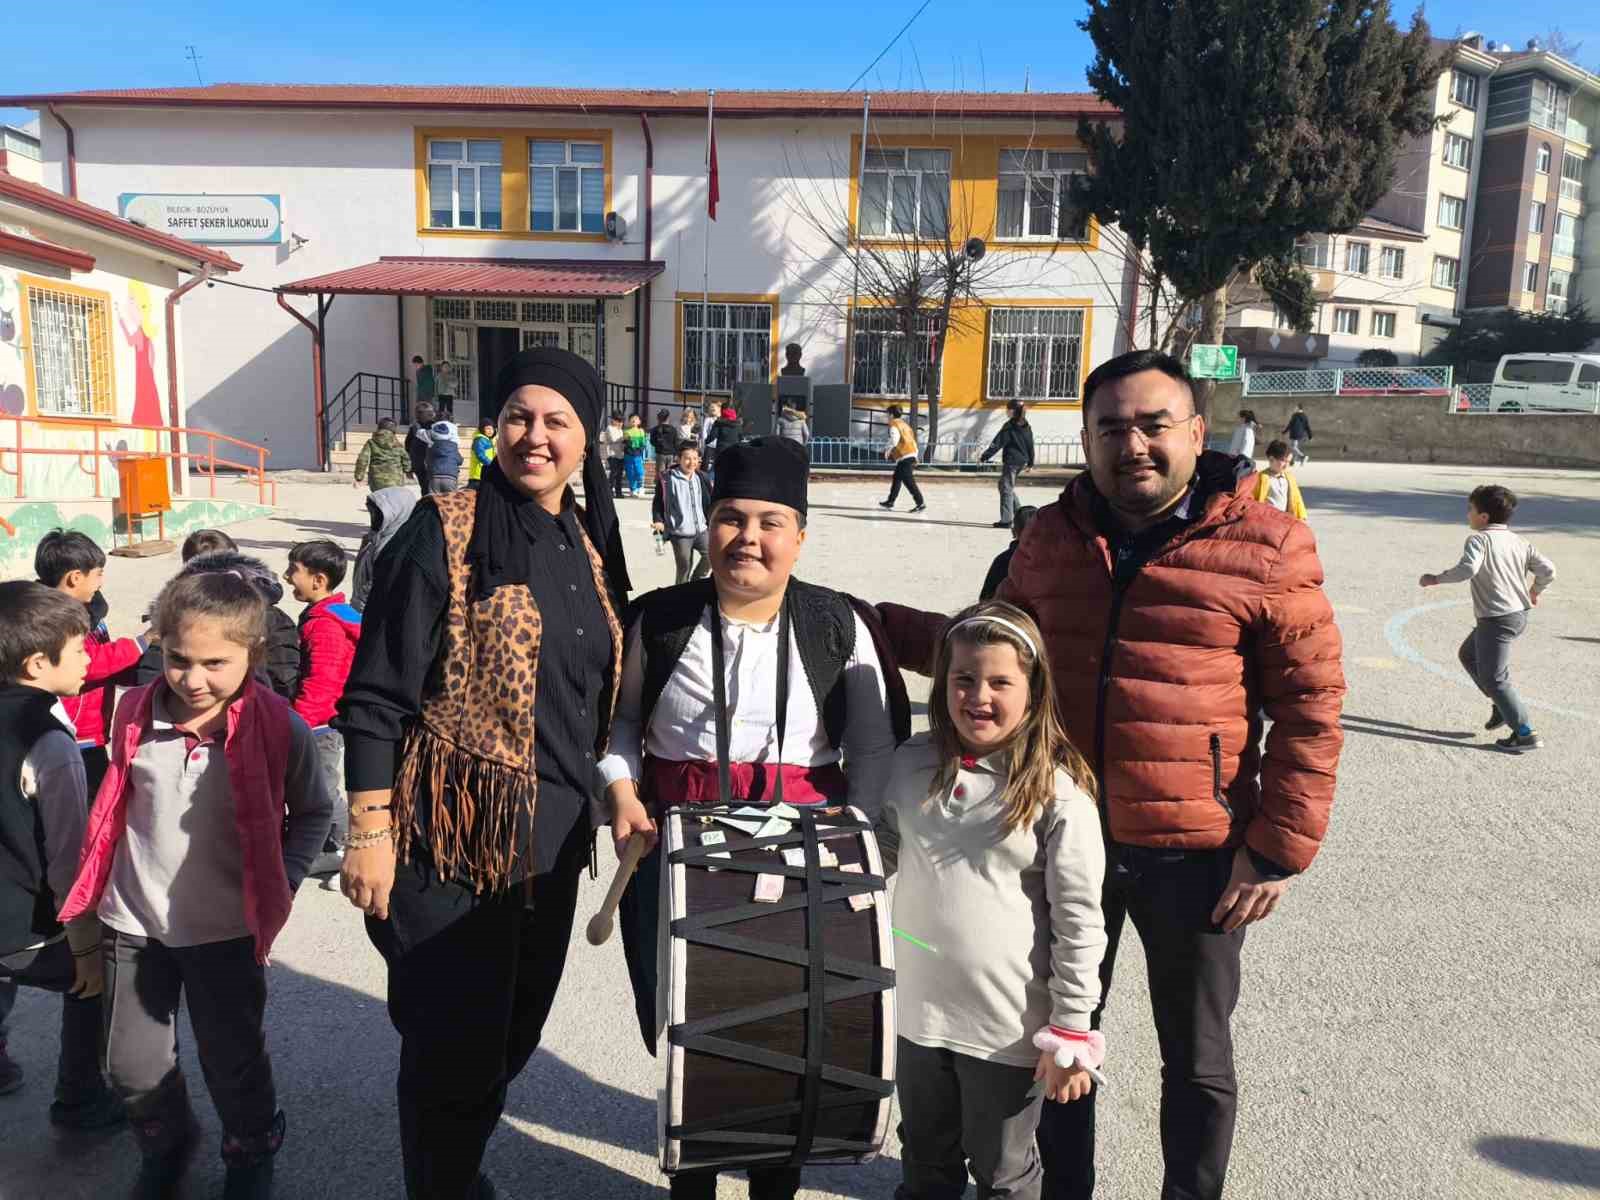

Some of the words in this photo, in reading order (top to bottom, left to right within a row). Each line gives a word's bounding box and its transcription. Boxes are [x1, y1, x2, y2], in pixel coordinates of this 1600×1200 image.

[168, 217, 197, 228] SAFFET
[200, 217, 225, 230] ŞEKER
[227, 215, 269, 228] İLKOKULU
